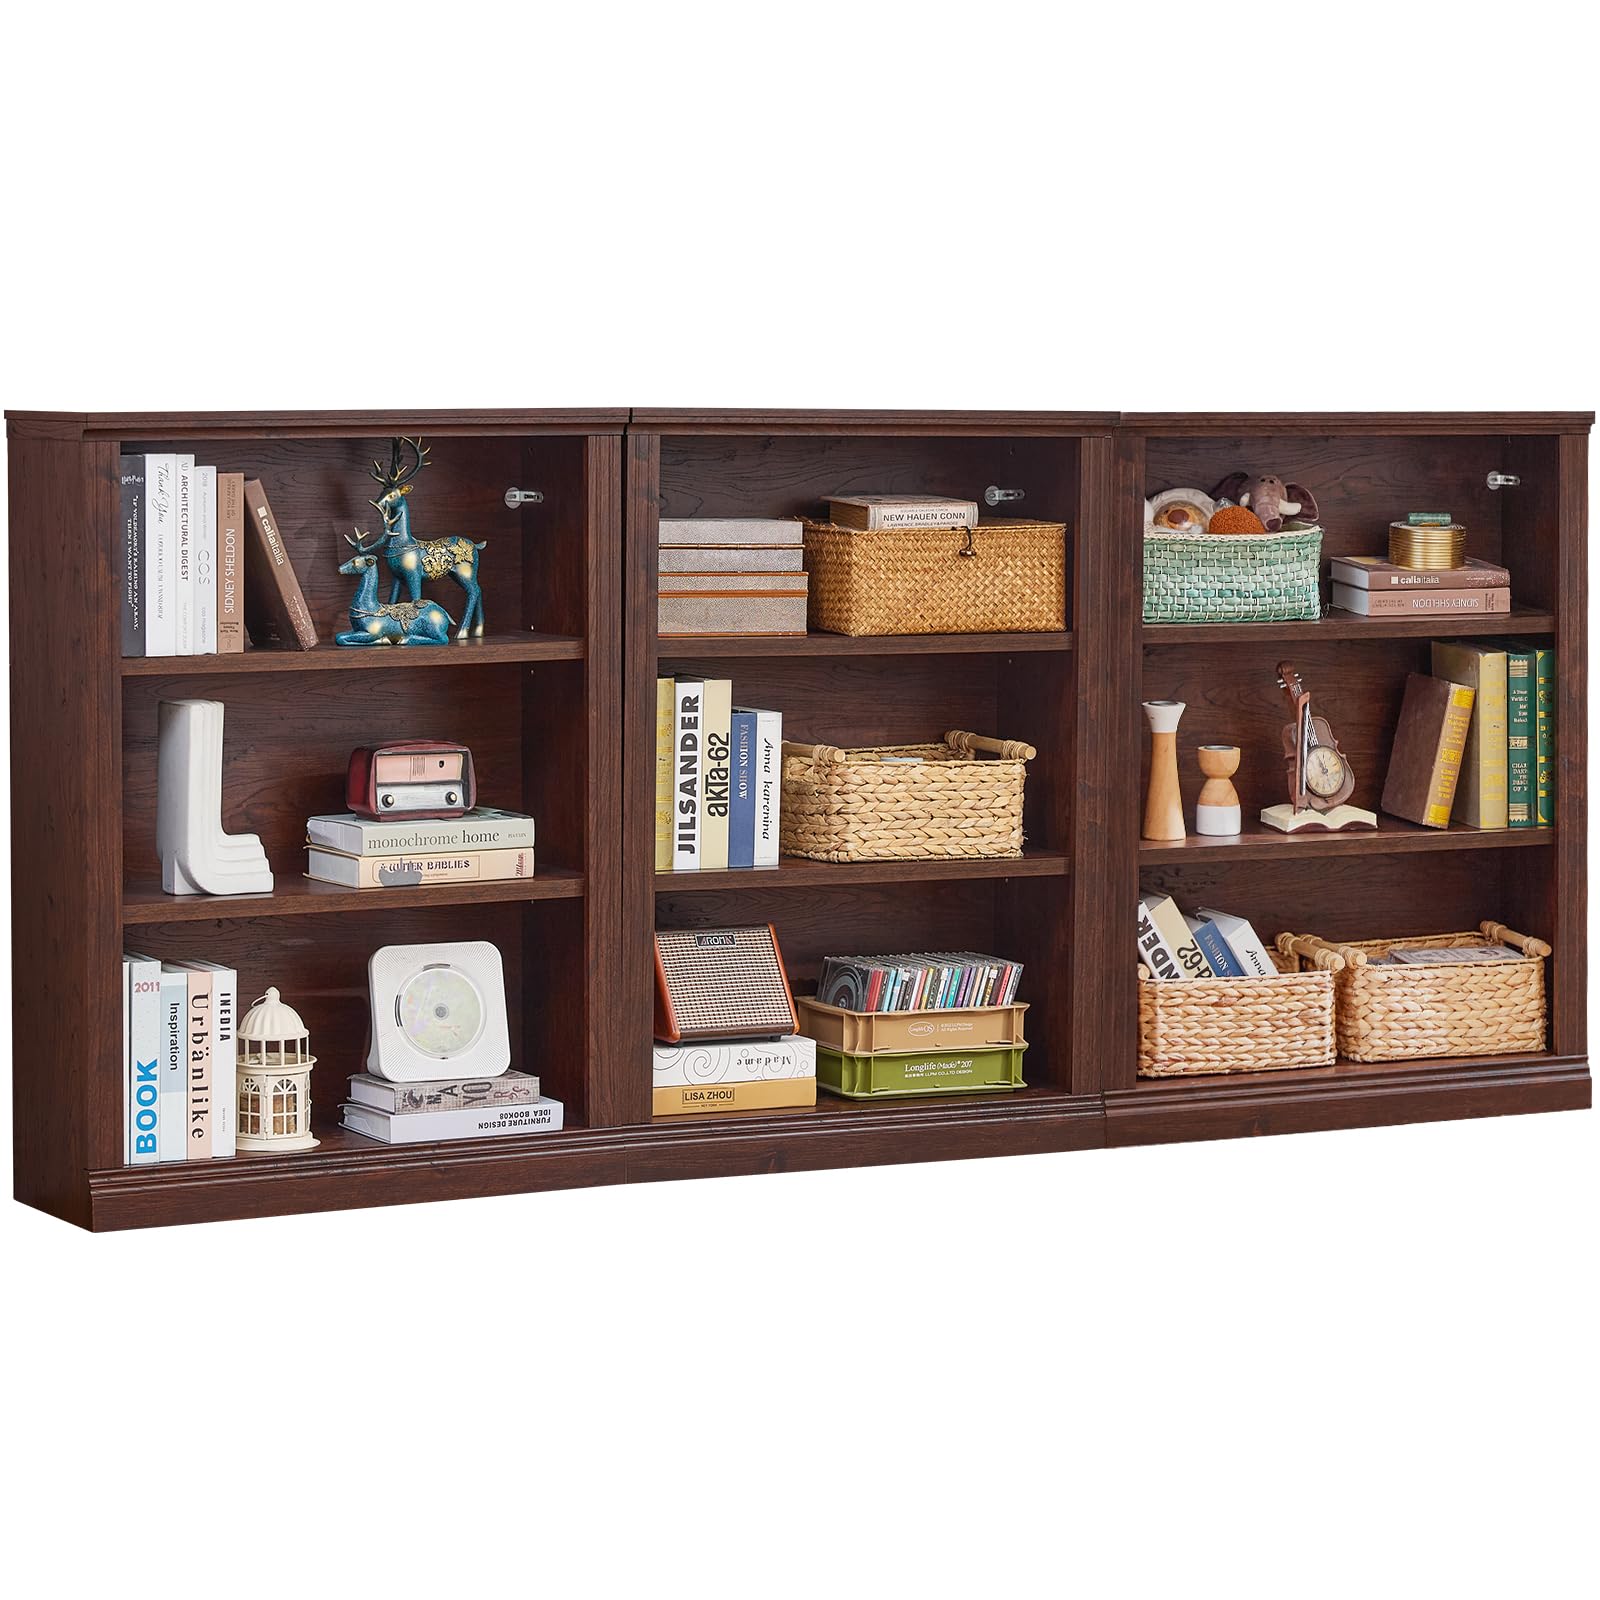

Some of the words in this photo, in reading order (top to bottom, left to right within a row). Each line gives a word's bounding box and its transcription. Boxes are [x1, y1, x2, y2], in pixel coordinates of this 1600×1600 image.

[156, 462, 170, 497] Thank
[151, 497, 170, 525] You
[180, 474, 189, 548] ARCHITECTURAL
[883, 514, 904, 522] NEW
[939, 512, 966, 520] CONN
[180, 549, 189, 582] DIGEST
[198, 549, 210, 586] COS
[224, 528, 235, 580] SHELDON
[127, 570, 132, 581] TO
[132, 591, 139, 603] AN
[224, 580, 235, 614] SIDNEY
[1412, 597, 1450, 609] SHELDON
[1451, 596, 1479, 608] SIDNEY
[739, 723, 750, 767] FASHION
[763, 737, 774, 774] Anna
[677, 694, 700, 855] JILSANDER
[738, 767, 749, 800] SHOW
[368, 832, 458, 849] monochrome
[462, 829, 500, 843] home
[427, 859, 470, 870] BABLIES
[1203, 933, 1229, 972] FASHION
[1245, 948, 1267, 976] Anna
[134, 981, 160, 993] 2011
[219, 992, 231, 1042] INEDIA
[169, 1002, 181, 1071] Inspiration
[736, 1055, 792, 1068] Madame
[904, 1061, 937, 1073] Longlife
[960, 1060, 973, 1068] 207
[136, 1058, 160, 1154] BOOK
[684, 1091, 705, 1101] LISA
[706, 1090, 732, 1100] ZHOU
[478, 1118, 507, 1130] DESIGN
[499, 1109, 530, 1119] BOOK08
[508, 1117, 551, 1128] FURNITURE
[533, 1108, 551, 1117] IDEA
